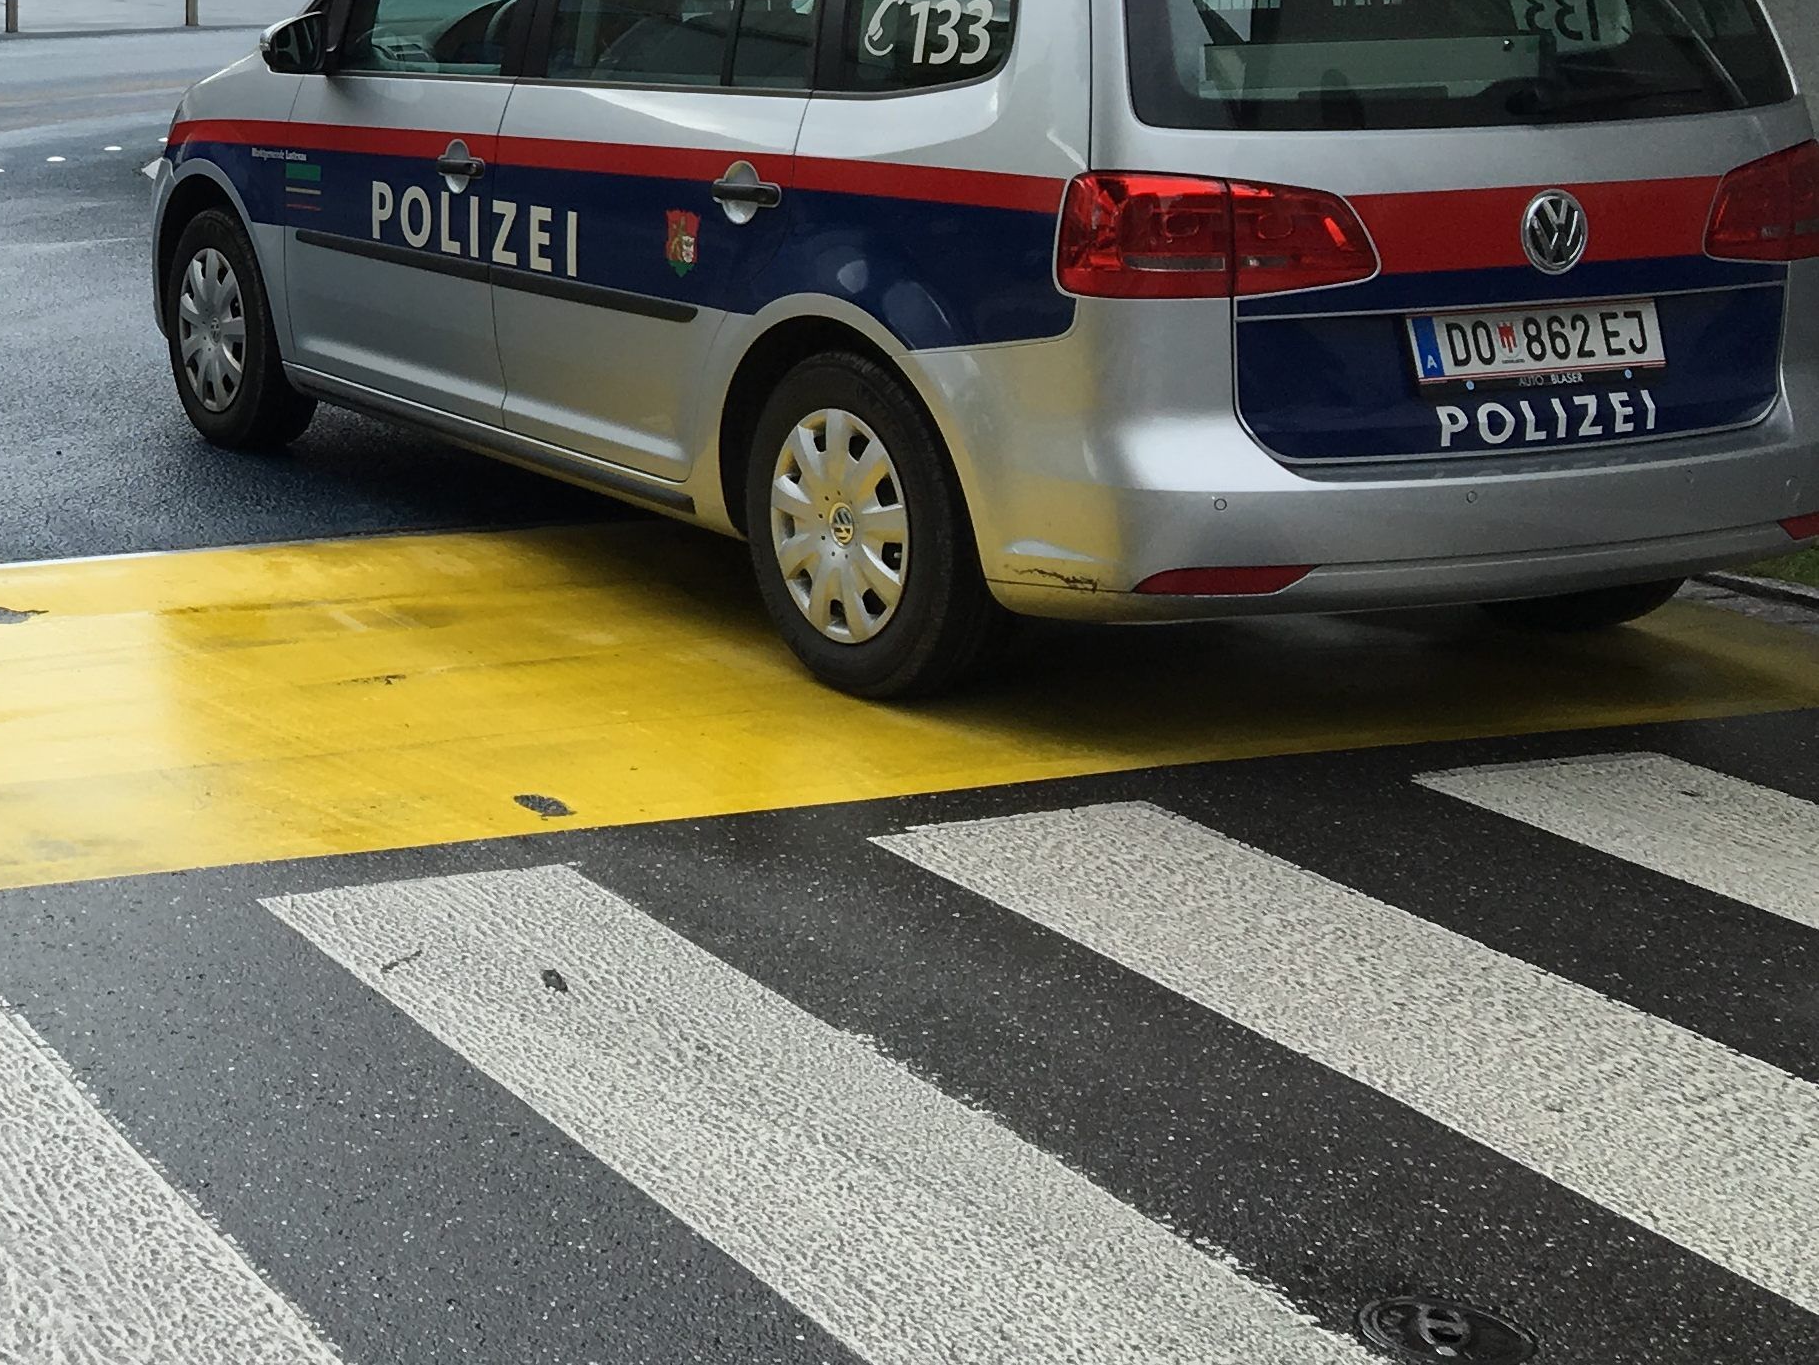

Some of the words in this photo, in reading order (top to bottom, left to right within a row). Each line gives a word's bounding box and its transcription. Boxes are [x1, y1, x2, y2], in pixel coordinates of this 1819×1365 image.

[372, 180, 578, 278] POLIZEI
[1426, 354, 1438, 370] A
[1445, 319, 1496, 367] DO
[1518, 373, 1545, 387] AUTO
[1551, 372, 1584, 385] BLASER
[1436, 389, 1656, 447] POLIZEI
